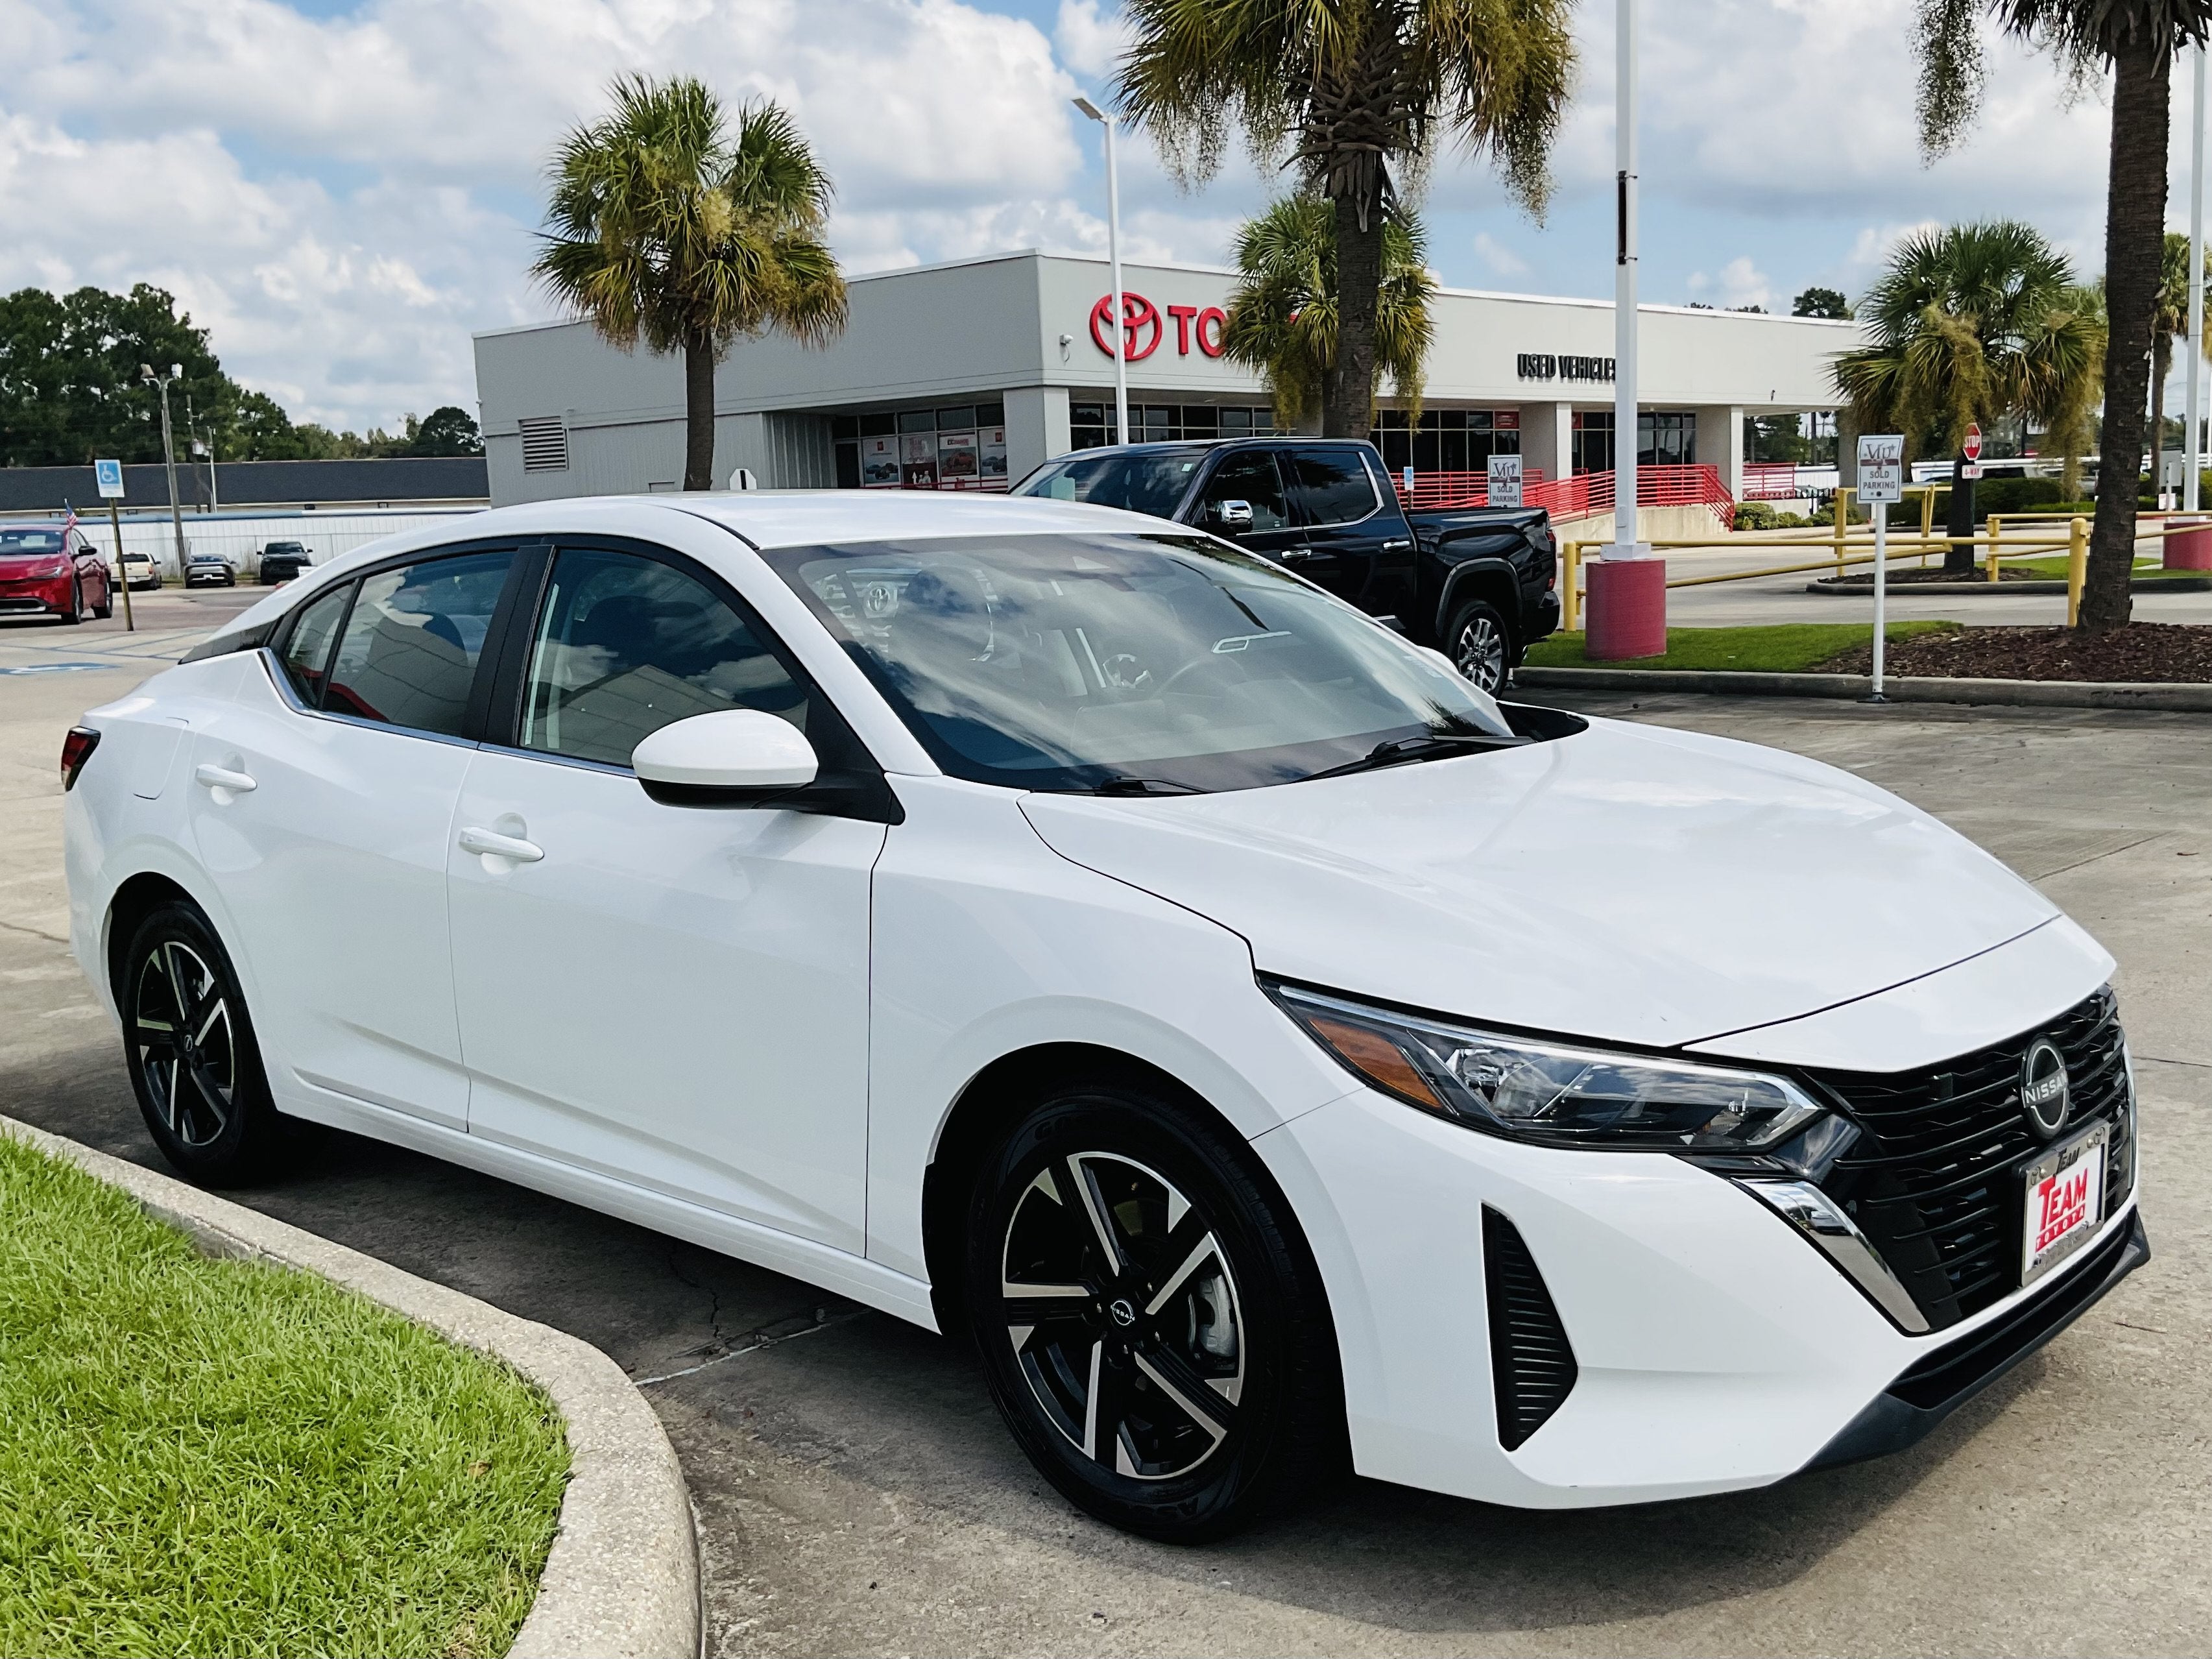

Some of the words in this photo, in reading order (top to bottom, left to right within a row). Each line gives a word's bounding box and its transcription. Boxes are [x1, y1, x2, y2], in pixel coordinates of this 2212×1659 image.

[1517, 354, 1556, 378] USED
[1558, 356, 1615, 380] VEHICLE
[1964, 435, 1980, 448] STOP
[1869, 470, 1890, 479] SOLD
[2054, 1146, 2080, 1177] TEAM
[2038, 1167, 2088, 1232] TEAM
[2036, 1207, 2084, 1249] TOYOTA
